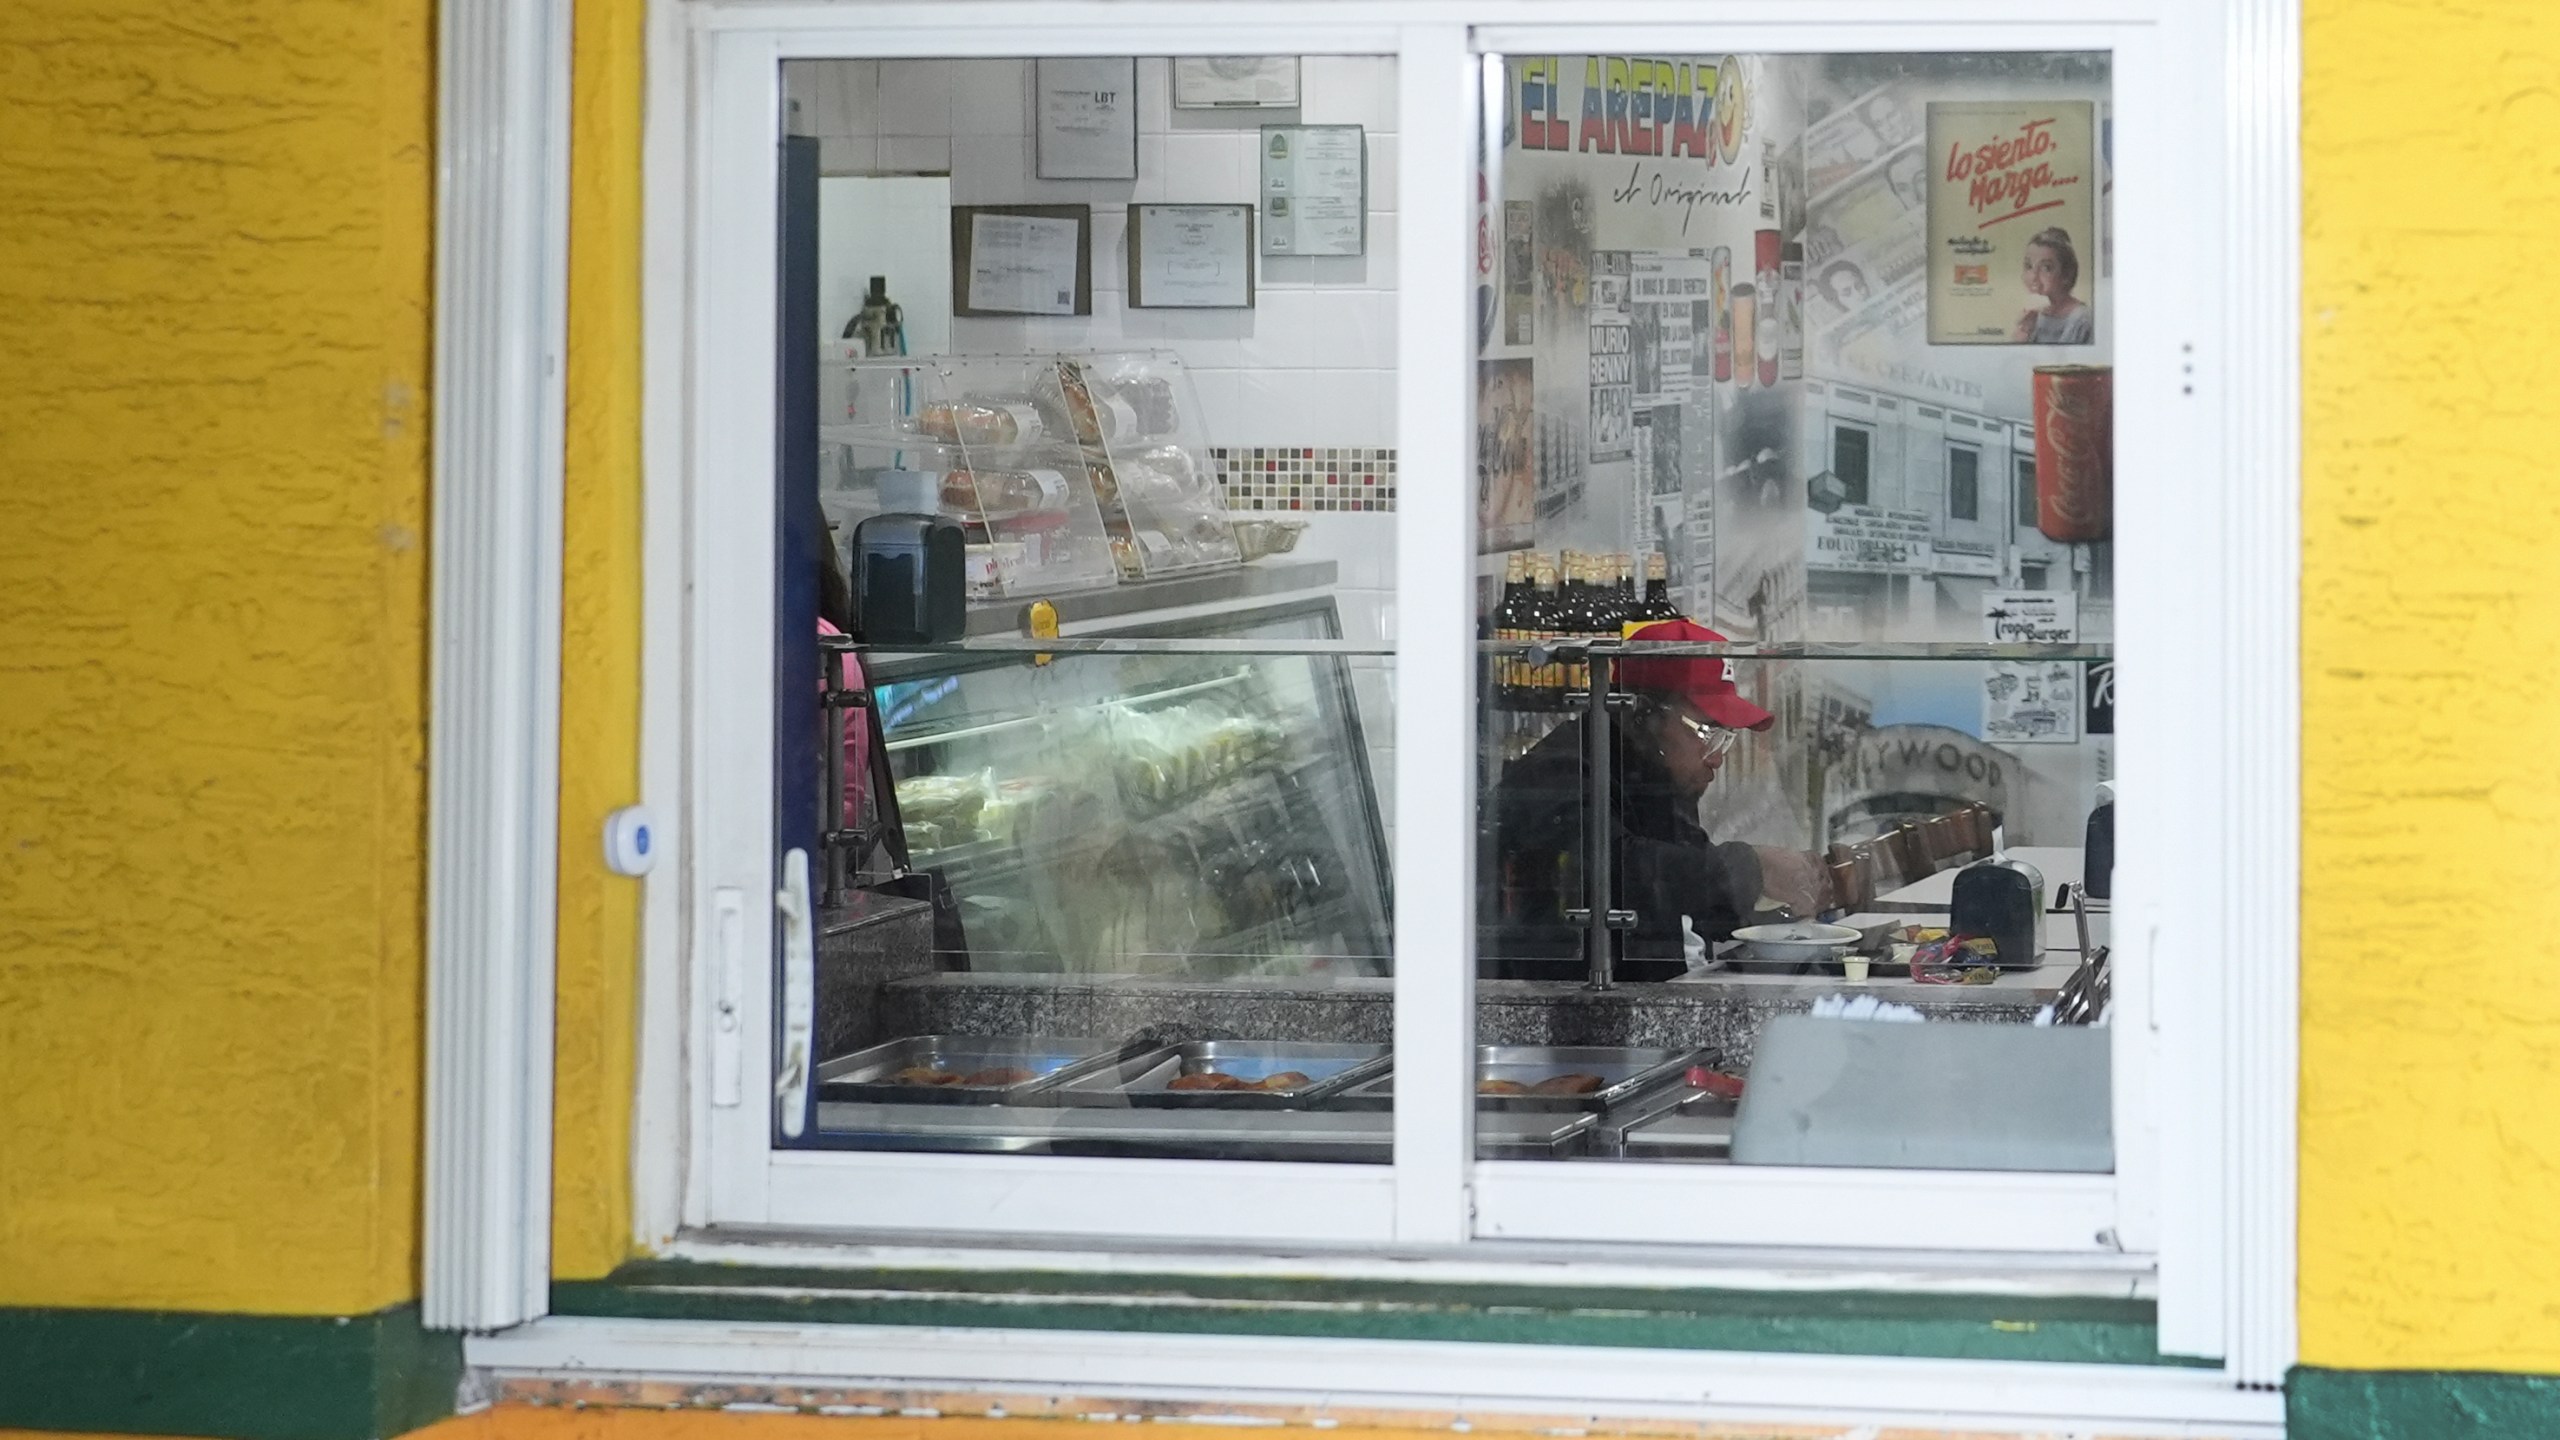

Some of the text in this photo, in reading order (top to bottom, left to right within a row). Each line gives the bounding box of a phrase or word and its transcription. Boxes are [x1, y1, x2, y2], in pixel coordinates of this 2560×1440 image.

[1521, 55, 1570, 151] EL
[1945, 140, 1975, 184] Lo
[1649, 164, 1752, 237] Original
[1591, 327, 1629, 354] MURIO
[1590, 355, 1630, 383] RENNY
